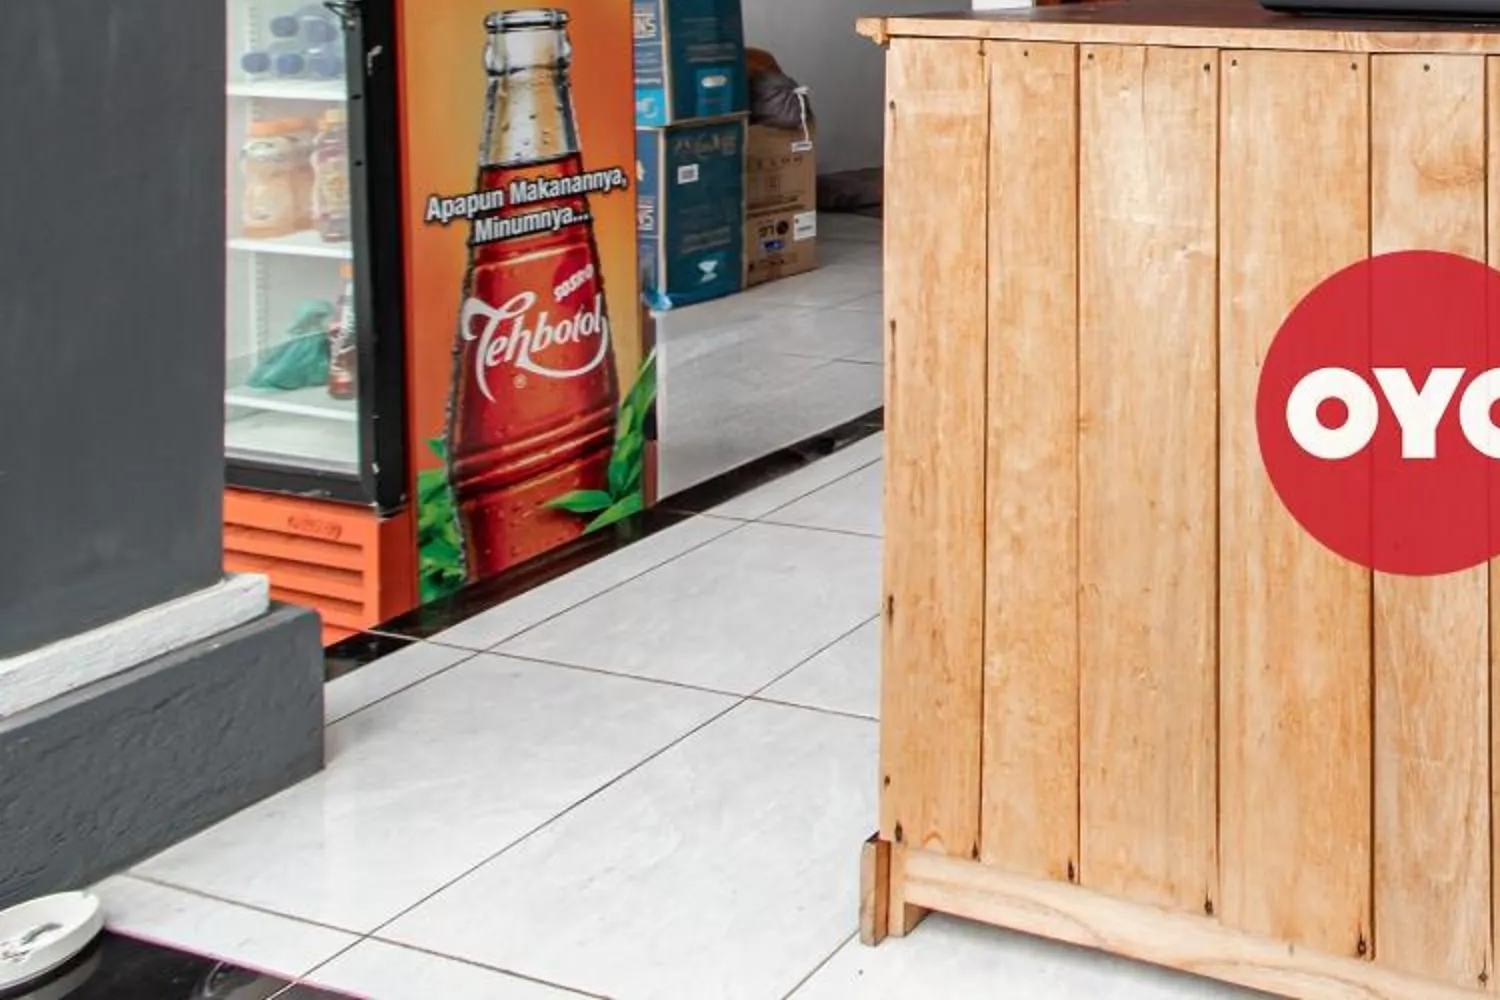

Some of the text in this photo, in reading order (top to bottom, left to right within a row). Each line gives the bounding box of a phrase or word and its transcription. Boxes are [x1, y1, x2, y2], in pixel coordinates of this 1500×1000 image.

[426, 168, 627, 222] Apapun Makanannya,
[474, 206, 589, 243] Minumnya...
[461, 291, 609, 403] Tehbotol
